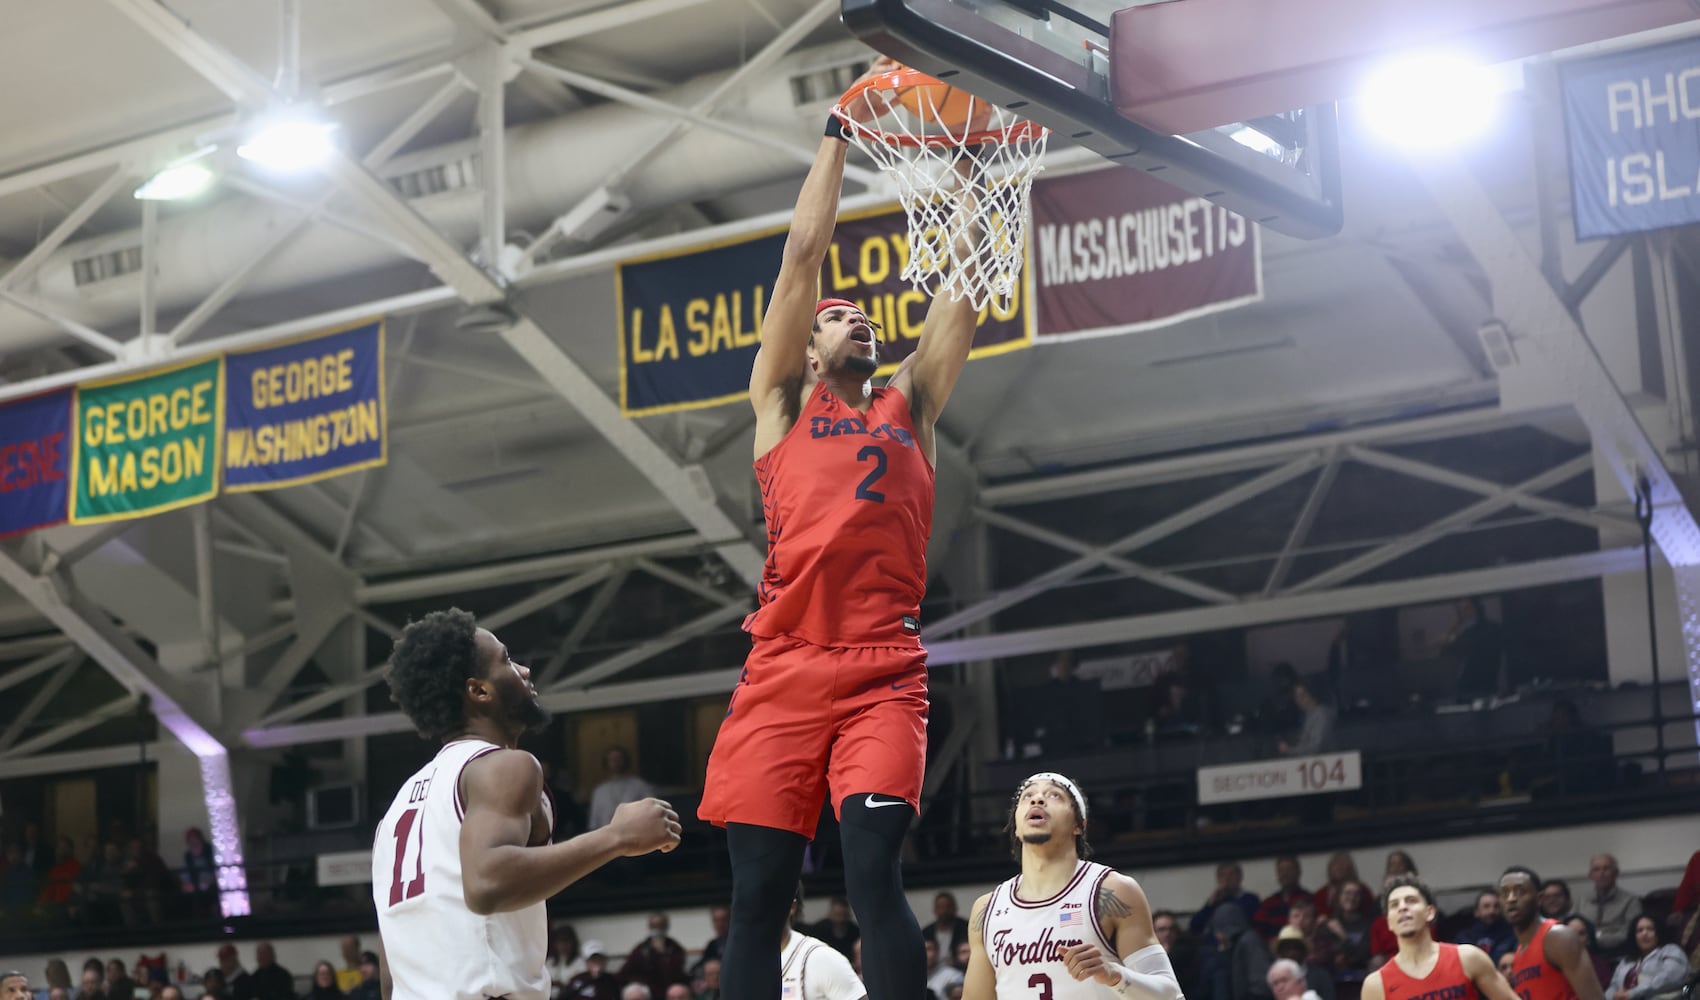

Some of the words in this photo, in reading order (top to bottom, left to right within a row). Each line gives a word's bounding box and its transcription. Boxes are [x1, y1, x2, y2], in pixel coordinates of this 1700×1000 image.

[1606, 149, 1700, 207] ISL
[632, 303, 679, 363] LA
[686, 285, 763, 356] SALL
[252, 349, 354, 409] GEORGE
[85, 380, 212, 448] GEORGE
[226, 400, 379, 469] WASHINGTON
[89, 436, 206, 498] MASON
[855, 446, 887, 503] 2
[1213, 769, 1287, 793] SECTION
[1297, 757, 1345, 790] 104
[389, 808, 425, 907] 11
